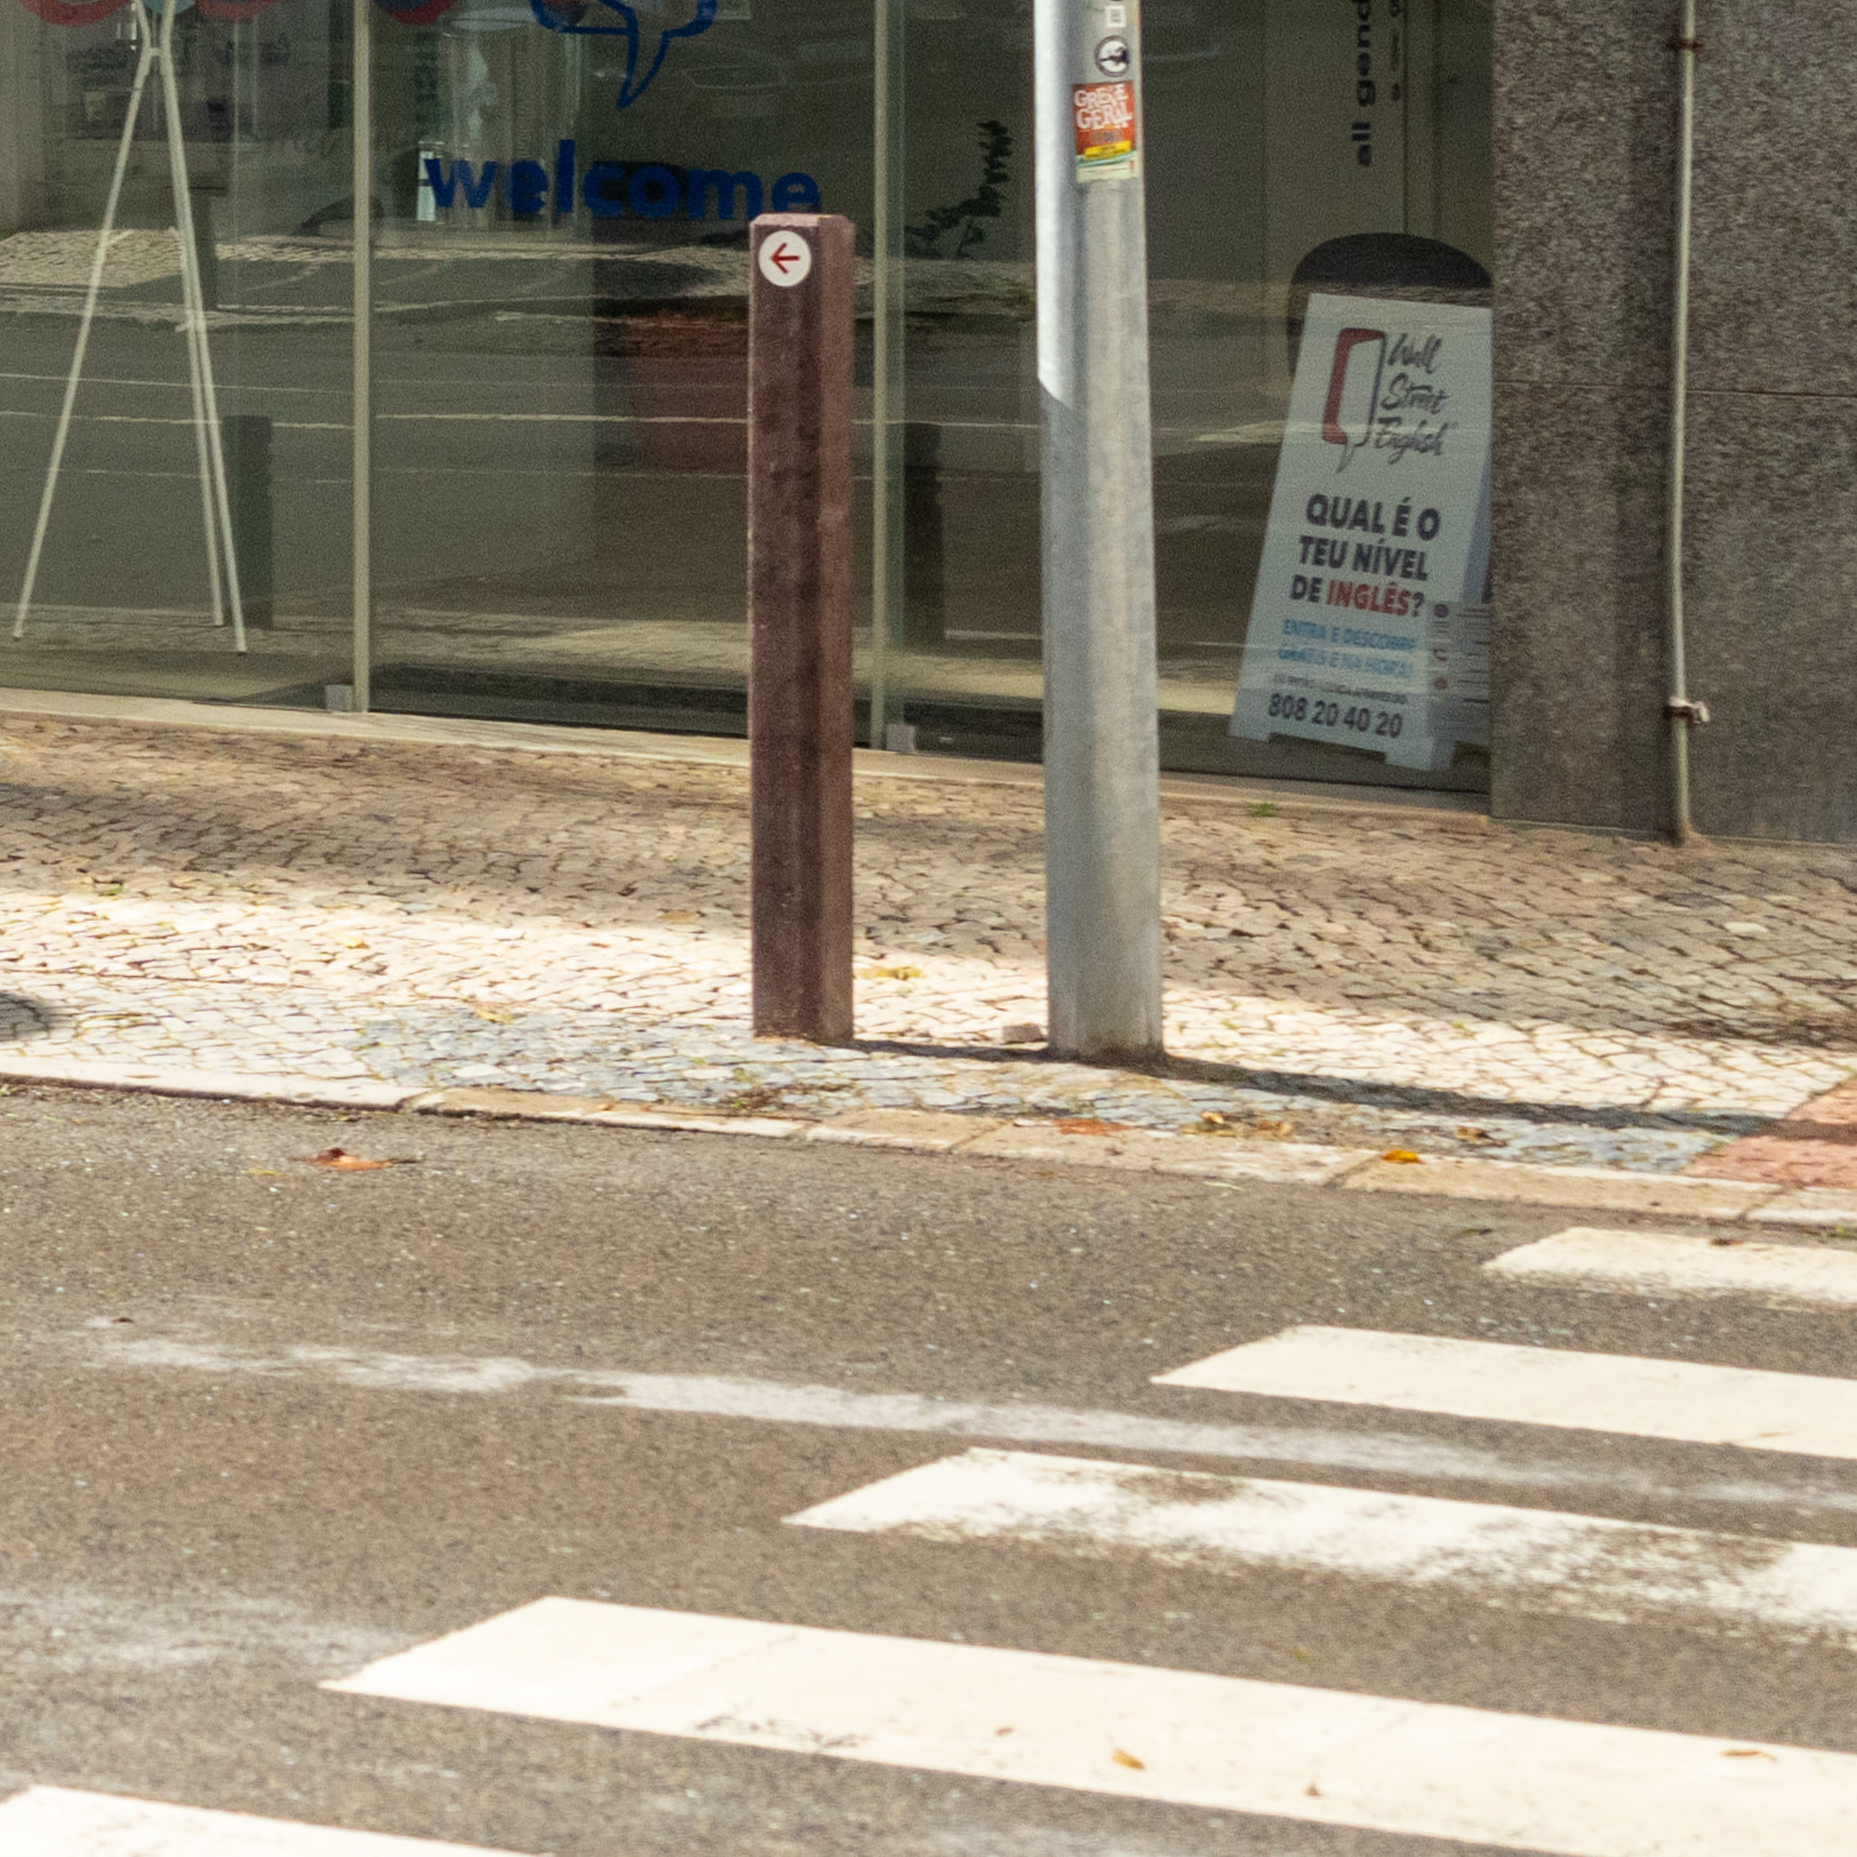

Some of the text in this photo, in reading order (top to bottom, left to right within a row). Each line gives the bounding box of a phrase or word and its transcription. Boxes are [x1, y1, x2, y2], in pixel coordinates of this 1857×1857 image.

[1076, 101, 1133, 130] GERAL
[1351, 121, 1373, 168] all
[423, 138, 821, 221] welcome
[1388, 333, 1442, 374] Wall
[1381, 373, 1450, 415] Street
[1305, 493, 1441, 541] QUAL É O
[1298, 534, 1429, 581] TEU NÍVEL
[1290, 573, 1425, 618] DE INGLÊS?
[1282, 618, 1327, 641] ENTRA
[1268, 692, 1404, 739] 808 20 40 20
